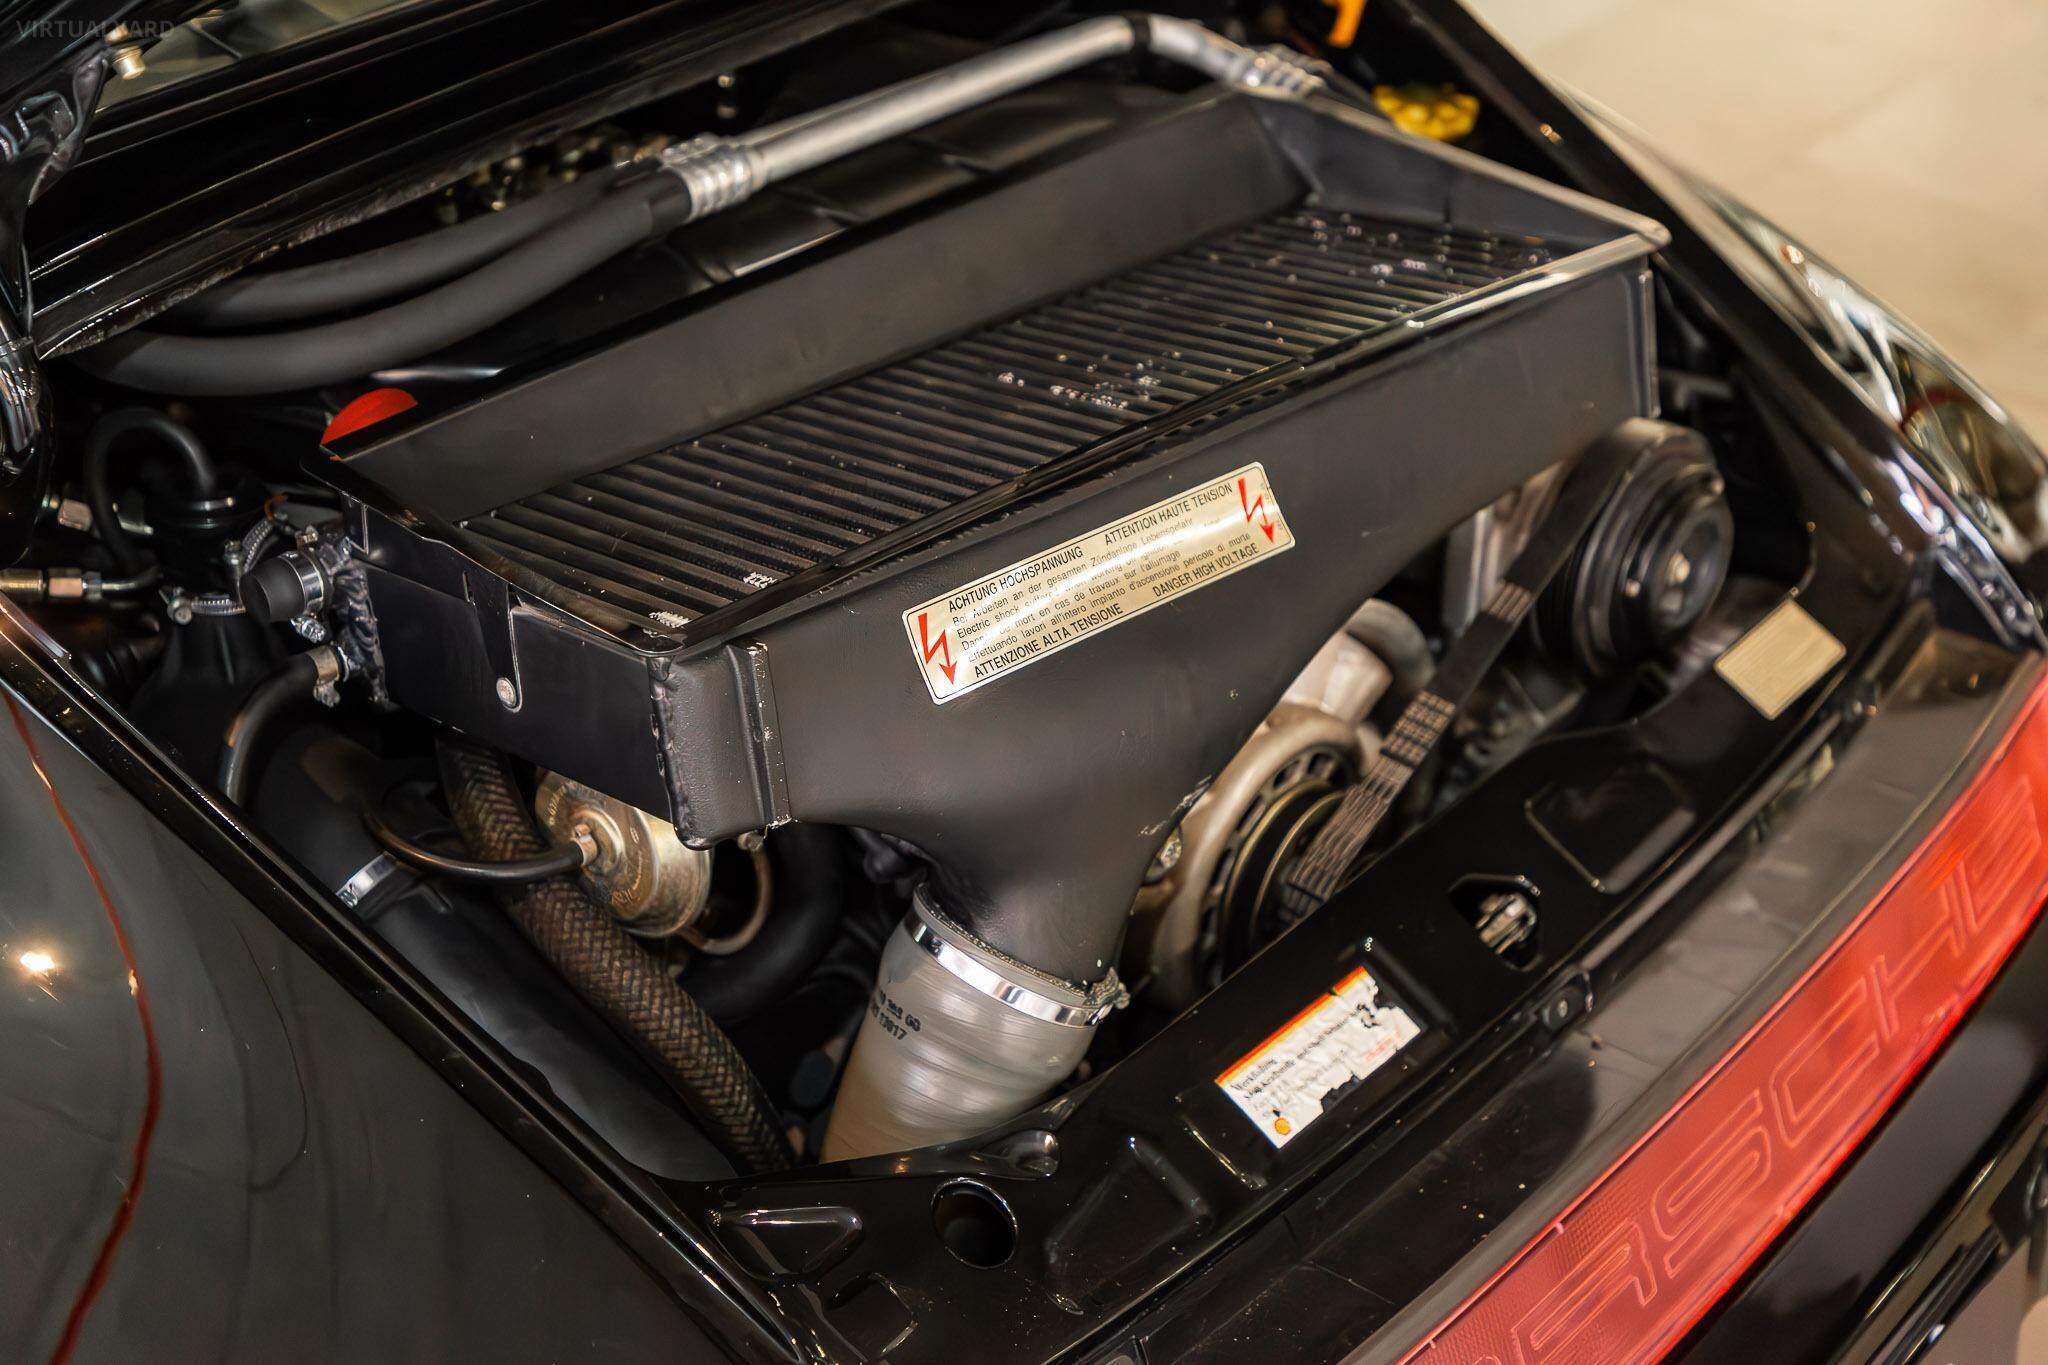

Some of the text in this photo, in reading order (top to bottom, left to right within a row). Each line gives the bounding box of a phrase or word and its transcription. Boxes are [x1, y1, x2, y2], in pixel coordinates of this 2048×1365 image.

[1104, 514, 1158, 547] ATTENTION
[1157, 500, 1192, 523] HAUTE
[1191, 482, 1233, 508] TENSION
[948, 545, 1084, 614] ACHTUNG HOCHSPANNUNG
[1012, 590, 1025, 601] an
[1027, 582, 1042, 594] der
[1046, 563, 1088, 588] gesamten
[1014, 612, 1036, 629] mort
[1038, 607, 1051, 618] en
[1054, 598, 1071, 611] cas
[1073, 592, 1086, 602] de
[1088, 576, 1119, 596] travaux
[1123, 568, 1137, 580] sur
[1020, 622, 1047, 639] lavori
[1182, 549, 1215, 569] pericolo
[1217, 543, 1226, 553] di
[1228, 532, 1251, 548] morte
[1152, 542, 1260, 597] DANGER HIGH VOLTAGE
[956, 618, 991, 639] Electric
[994, 604, 1021, 623] shock
[974, 602, 1124, 678] ATTENZIONE ALTA TENSIONE
